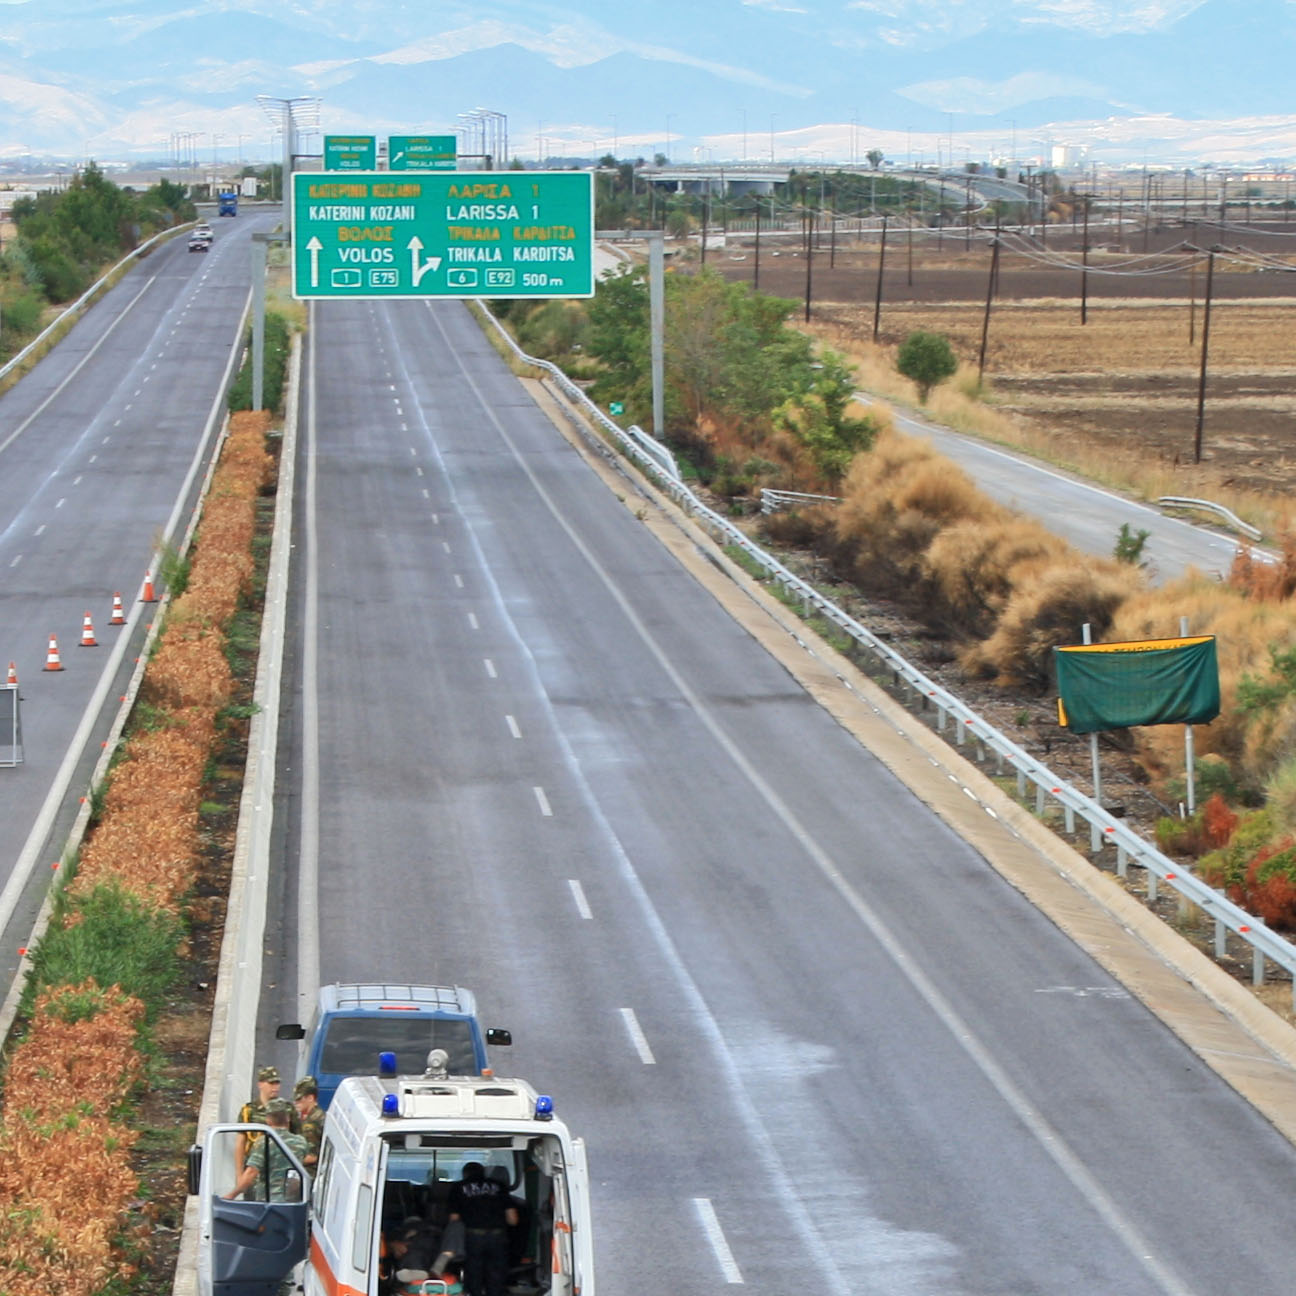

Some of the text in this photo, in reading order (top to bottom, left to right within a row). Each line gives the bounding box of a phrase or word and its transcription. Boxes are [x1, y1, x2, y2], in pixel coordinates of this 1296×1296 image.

[309, 205, 415, 221] KATERINI KOZANI
[446, 205, 539, 220] LARISSA 1
[338, 226, 394, 242] ΒΟΛΟΣ
[338, 247, 394, 263] VOLOS
[448, 247, 575, 262] TRIKALA KARDITSA
[343, 273, 349, 284] 1
[372, 272, 396, 284] E75
[458, 272, 466, 284] 6
[488, 272, 512, 284] E92
[522, 273, 547, 286] 500
